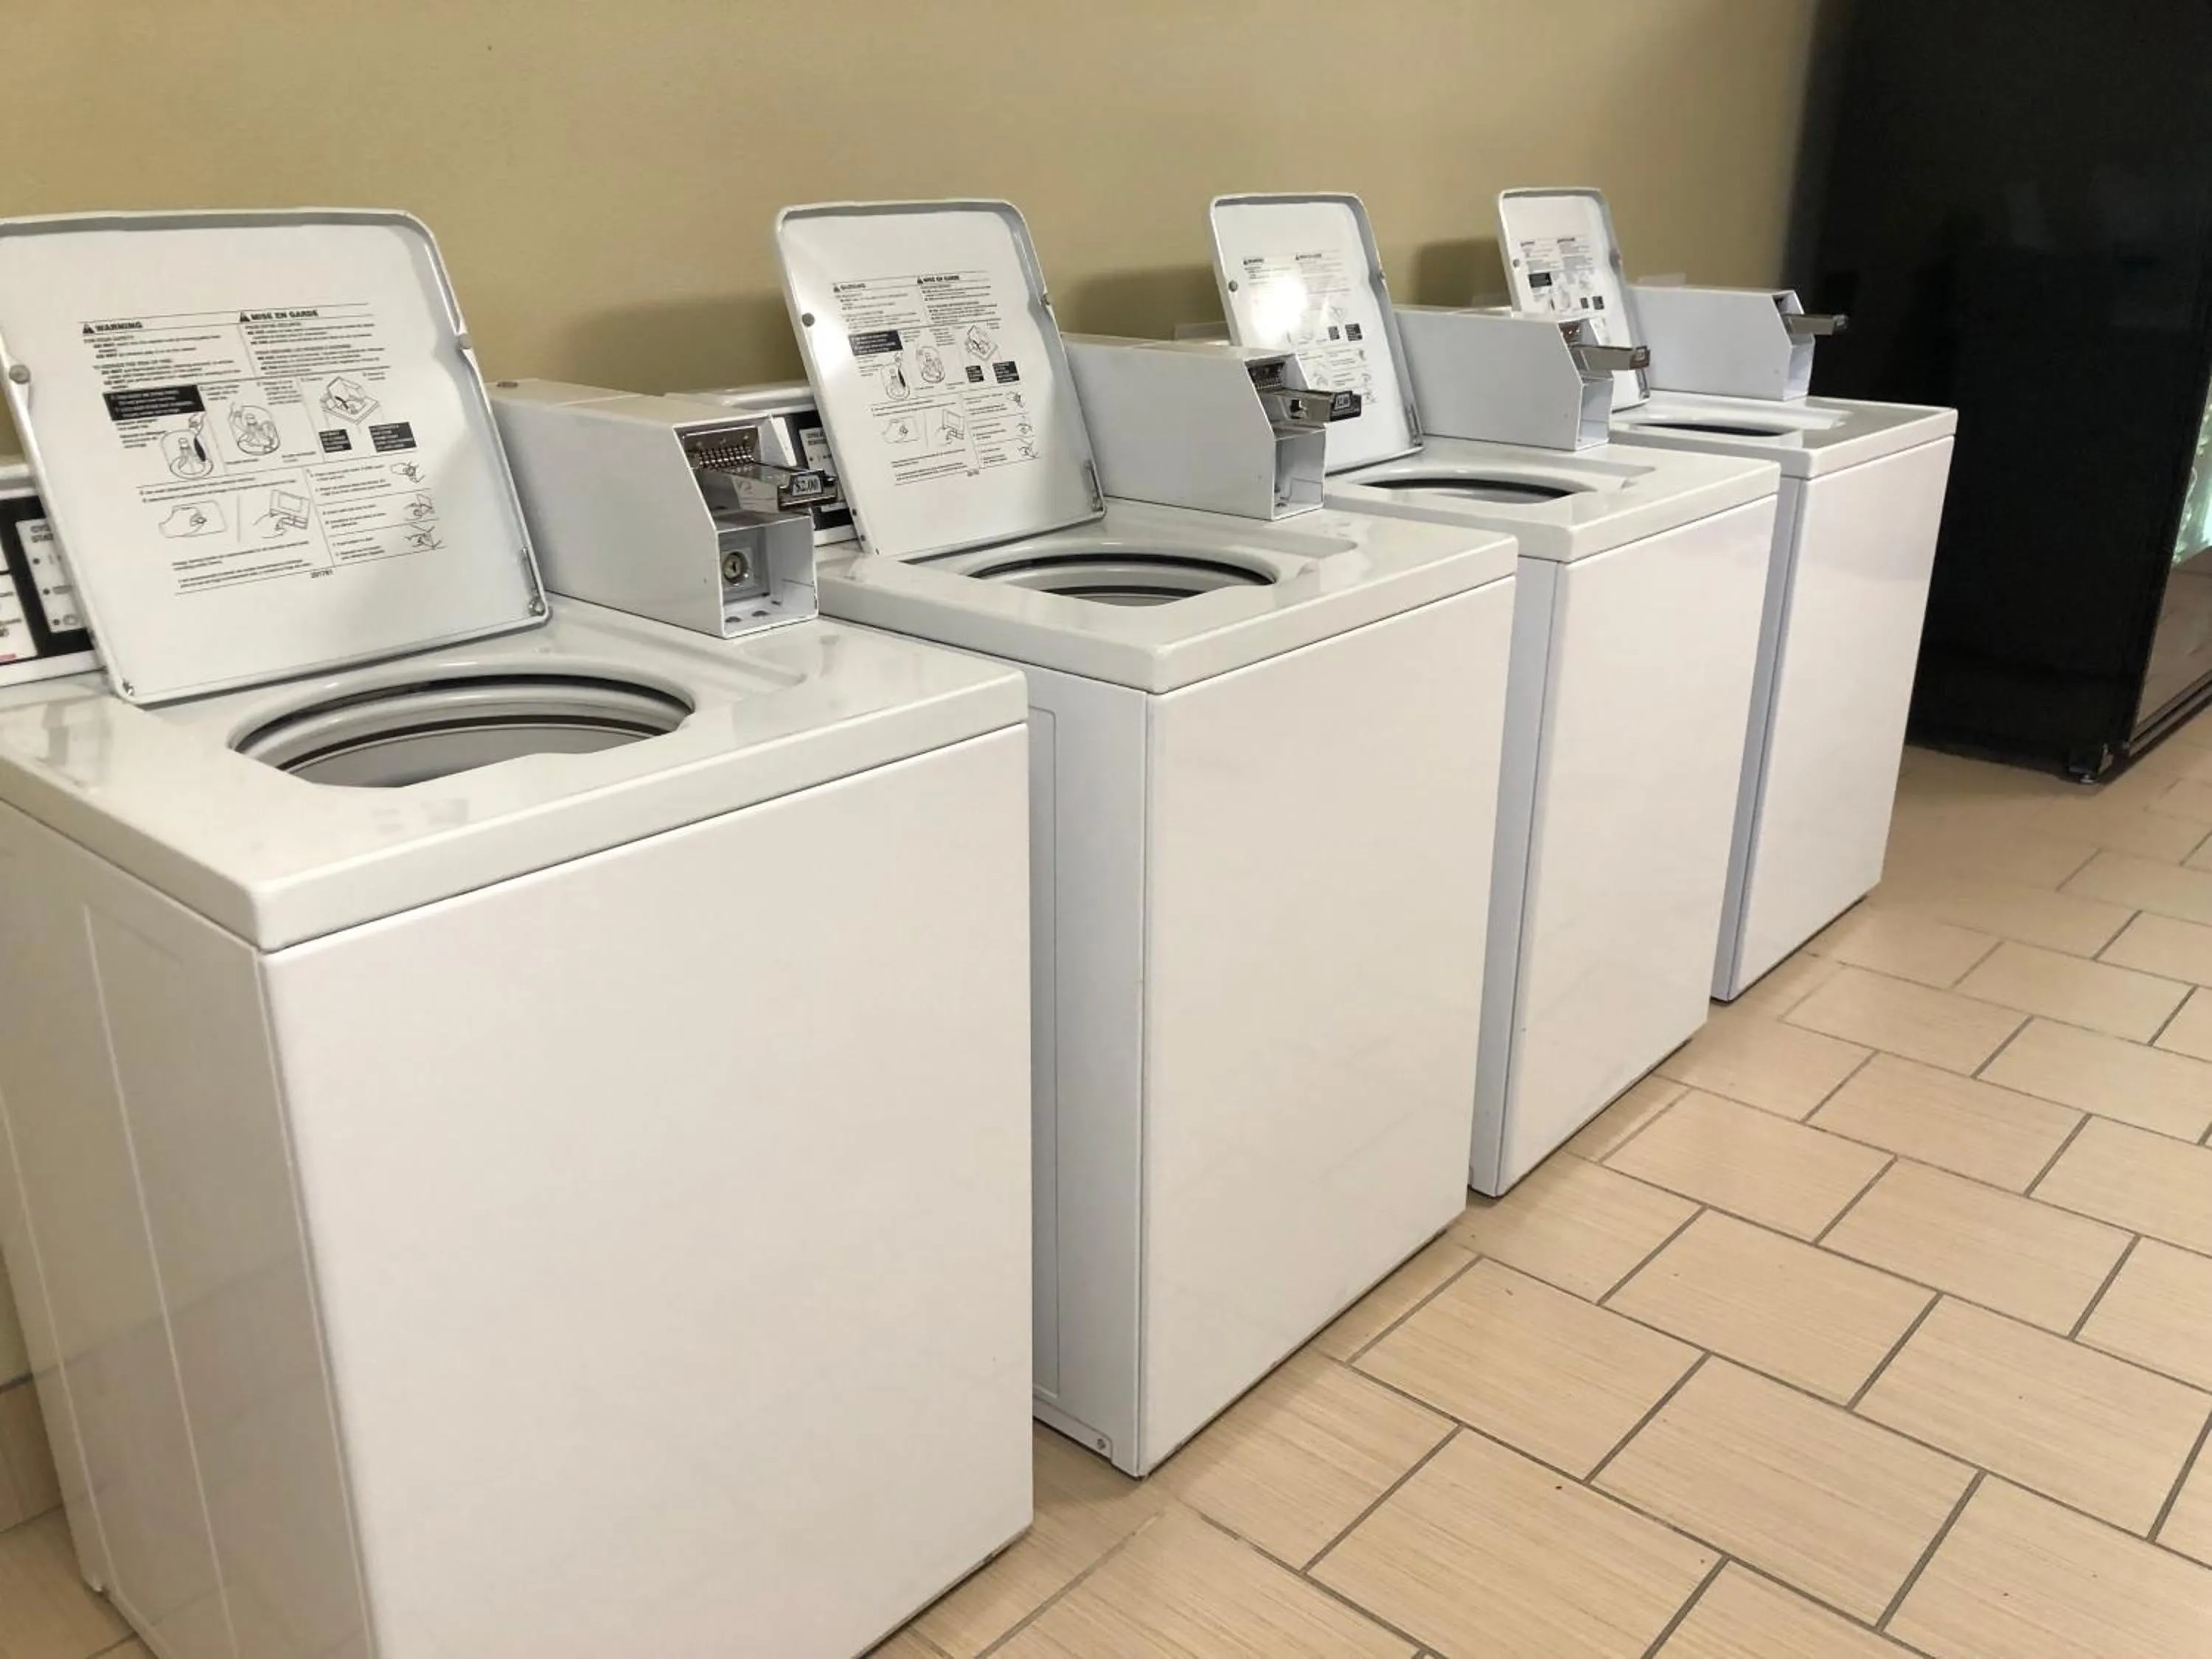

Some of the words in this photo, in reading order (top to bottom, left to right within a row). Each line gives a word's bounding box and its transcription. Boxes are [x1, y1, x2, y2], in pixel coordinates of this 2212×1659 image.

[251, 312, 273, 321] MISE
[288, 310, 319, 318] GARDE
[94, 321, 142, 332] WARNING
